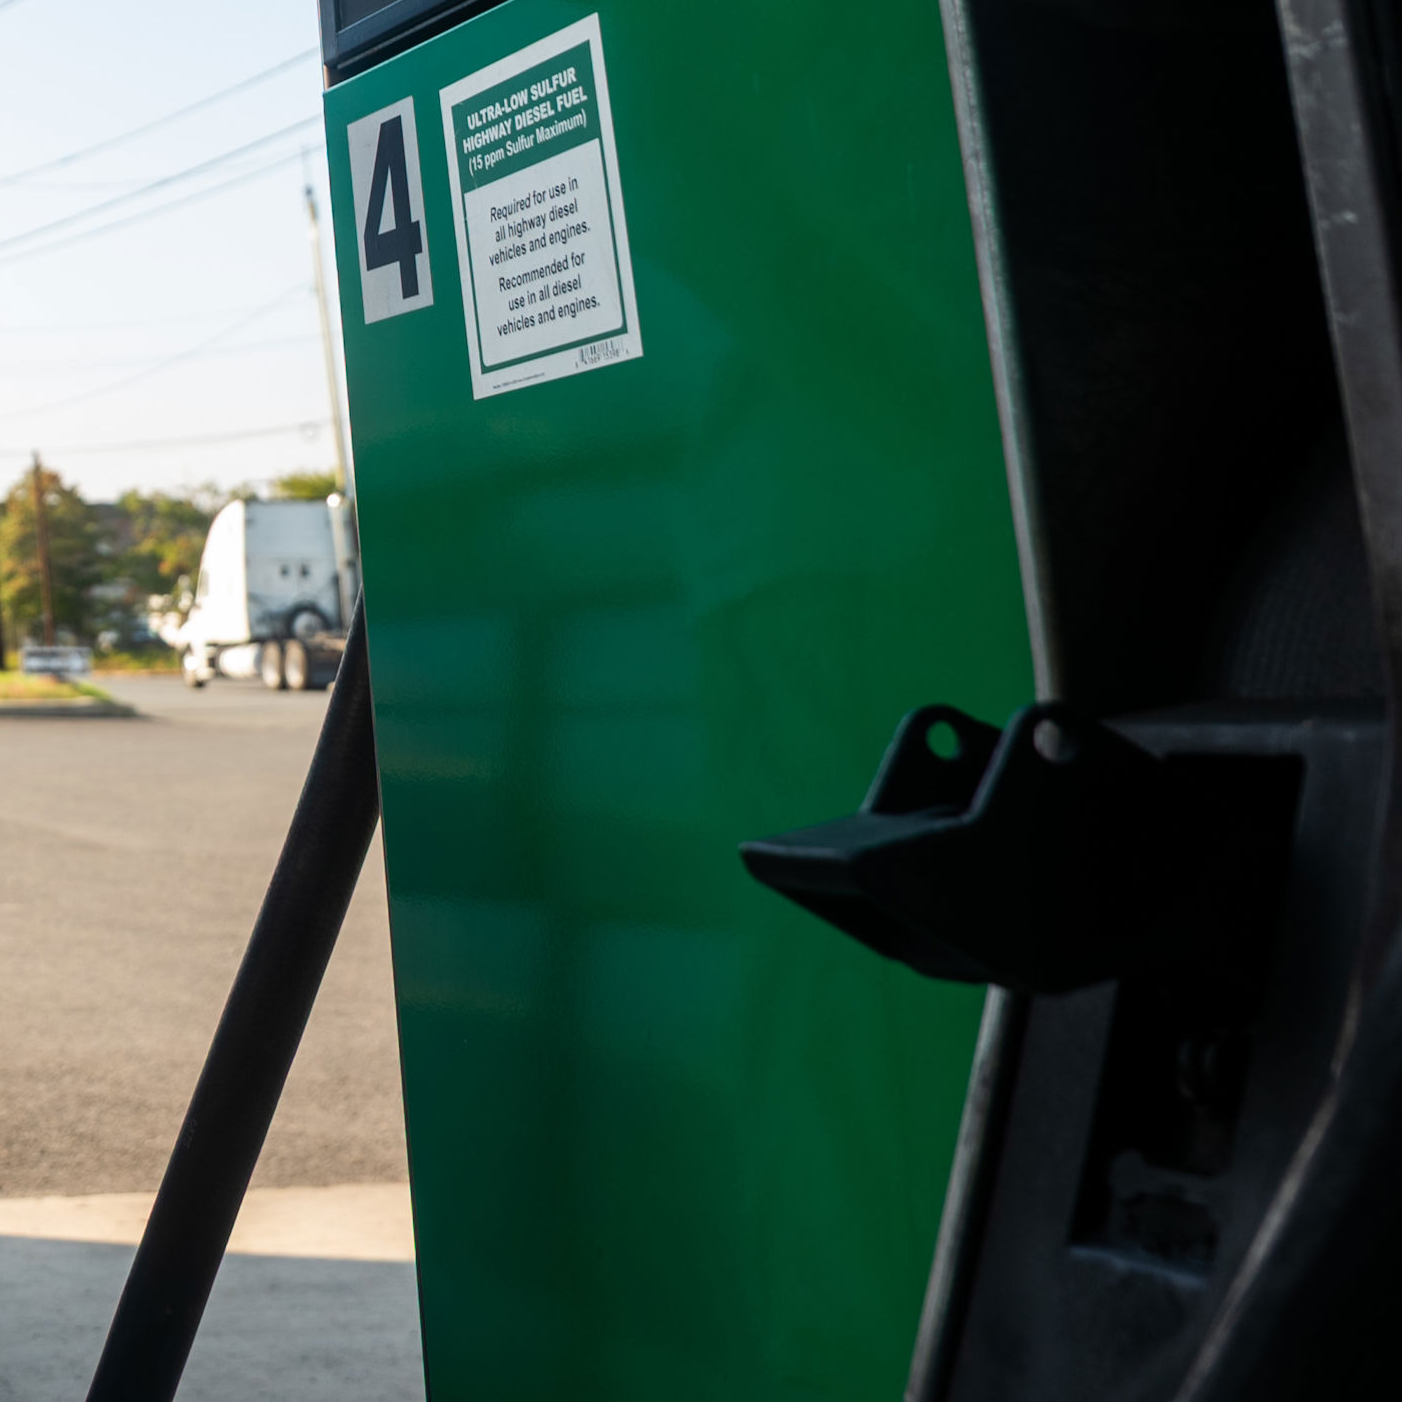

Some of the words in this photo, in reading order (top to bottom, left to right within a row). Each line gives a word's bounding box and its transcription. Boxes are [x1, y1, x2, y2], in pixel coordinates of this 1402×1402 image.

[462, 118, 512, 154] HIGHWAY
[514, 100, 555, 131] DIESEL
[556, 86, 588, 112] FUEL
[467, 88, 528, 131] ULTRA-LOW
[530, 67, 577, 101] SULFUR
[468, 154, 483, 177] (15
[484, 147, 505, 170] ppm
[506, 133, 535, 157] Sulfur
[536, 108, 587, 144] Maximum)
[364, 115, 423, 300] 4
[490, 193, 531, 223] Required
[532, 190, 546, 206] for
[549, 182, 566, 199] use
[568, 177, 579, 192] in
[495, 225, 506, 243] all
[508, 213, 547, 239] highway
[549, 198, 578, 222] diesel
[489, 243, 527, 266] vehicles
[529, 233, 547, 252] and
[549, 221, 591, 245] engines.
[499, 254, 569, 293] Recommended
[571, 251, 585, 268] for
[508, 296, 525, 311] use
[527, 290, 537, 306] in
[539, 283, 551, 302] all
[552, 273, 582, 297] diesel
[497, 315, 535, 337] vehicles
[538, 305, 556, 325] and
[558, 295, 601, 319] engines.
